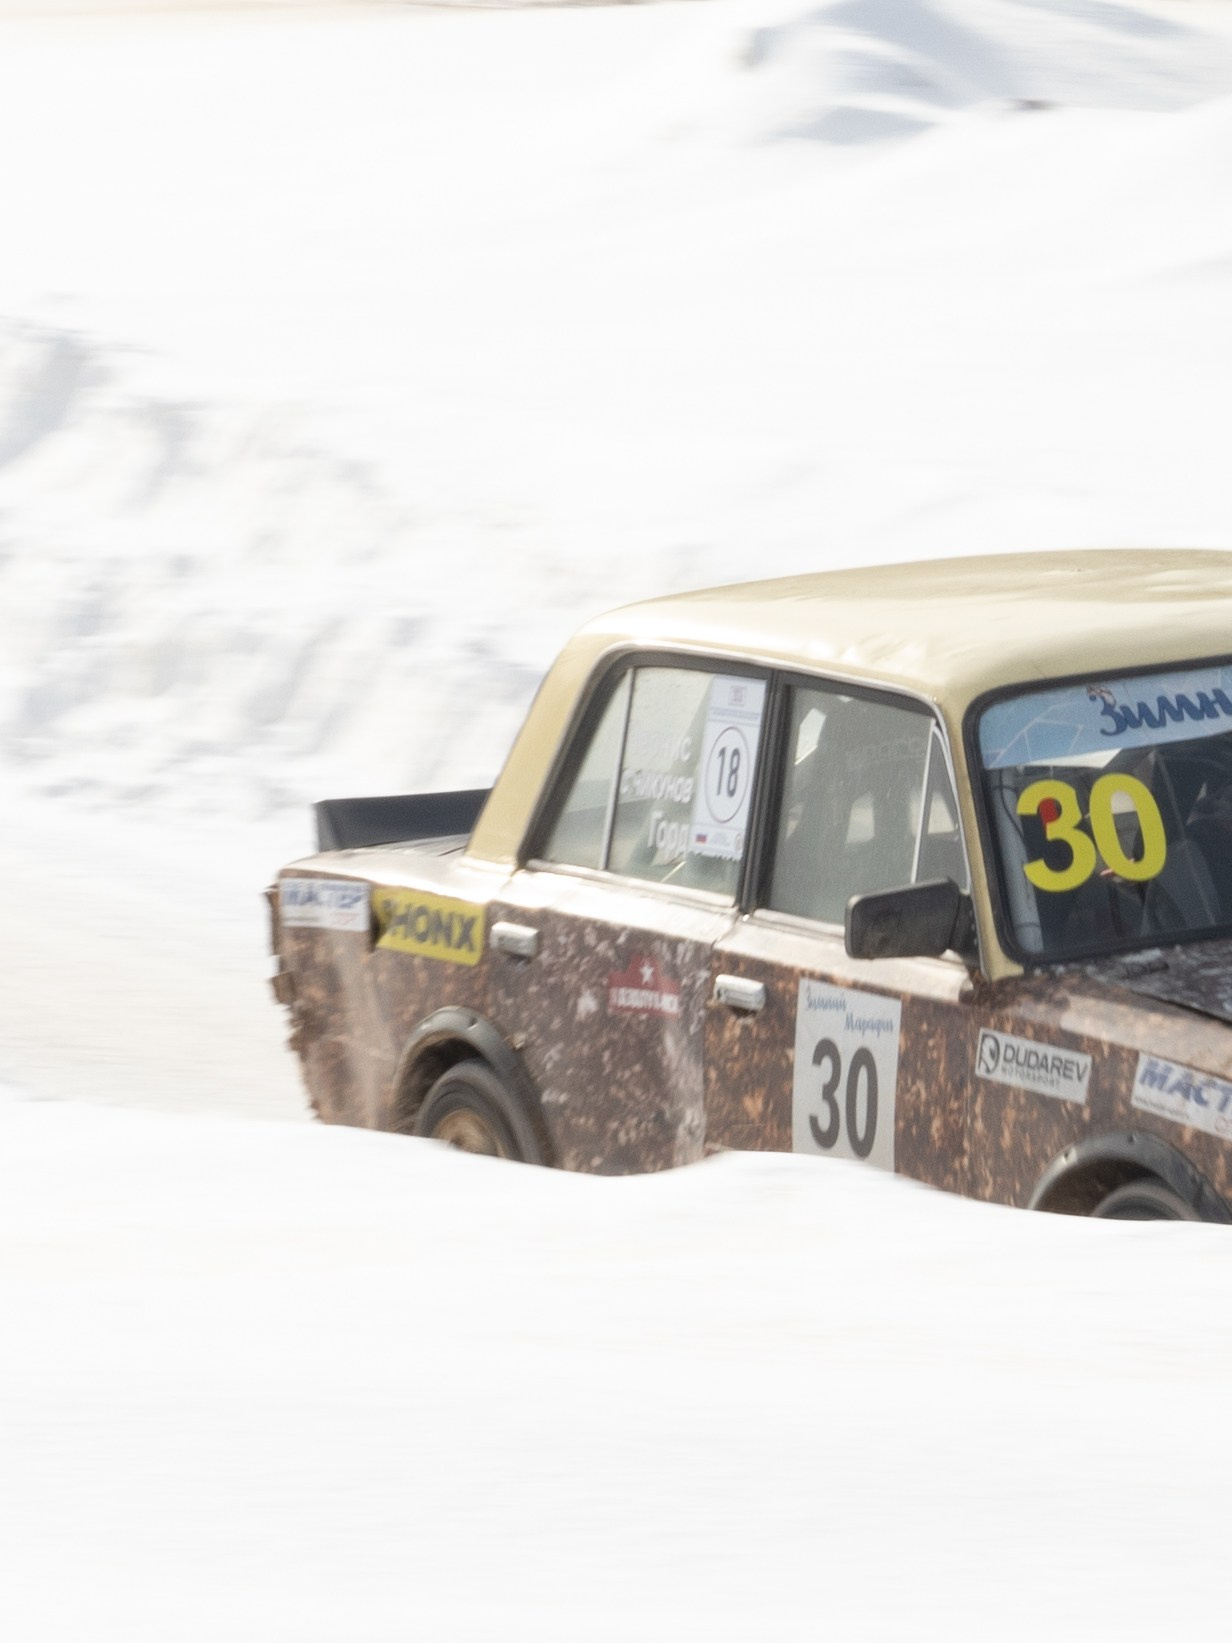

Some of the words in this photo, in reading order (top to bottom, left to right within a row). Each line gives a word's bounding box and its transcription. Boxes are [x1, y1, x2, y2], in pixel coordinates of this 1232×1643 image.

[716, 746, 741, 798] 18
[1016, 772, 1167, 892] 30
[809, 1037, 878, 1160] 30
[1002, 1043, 1089, 1083] DUDAREV
